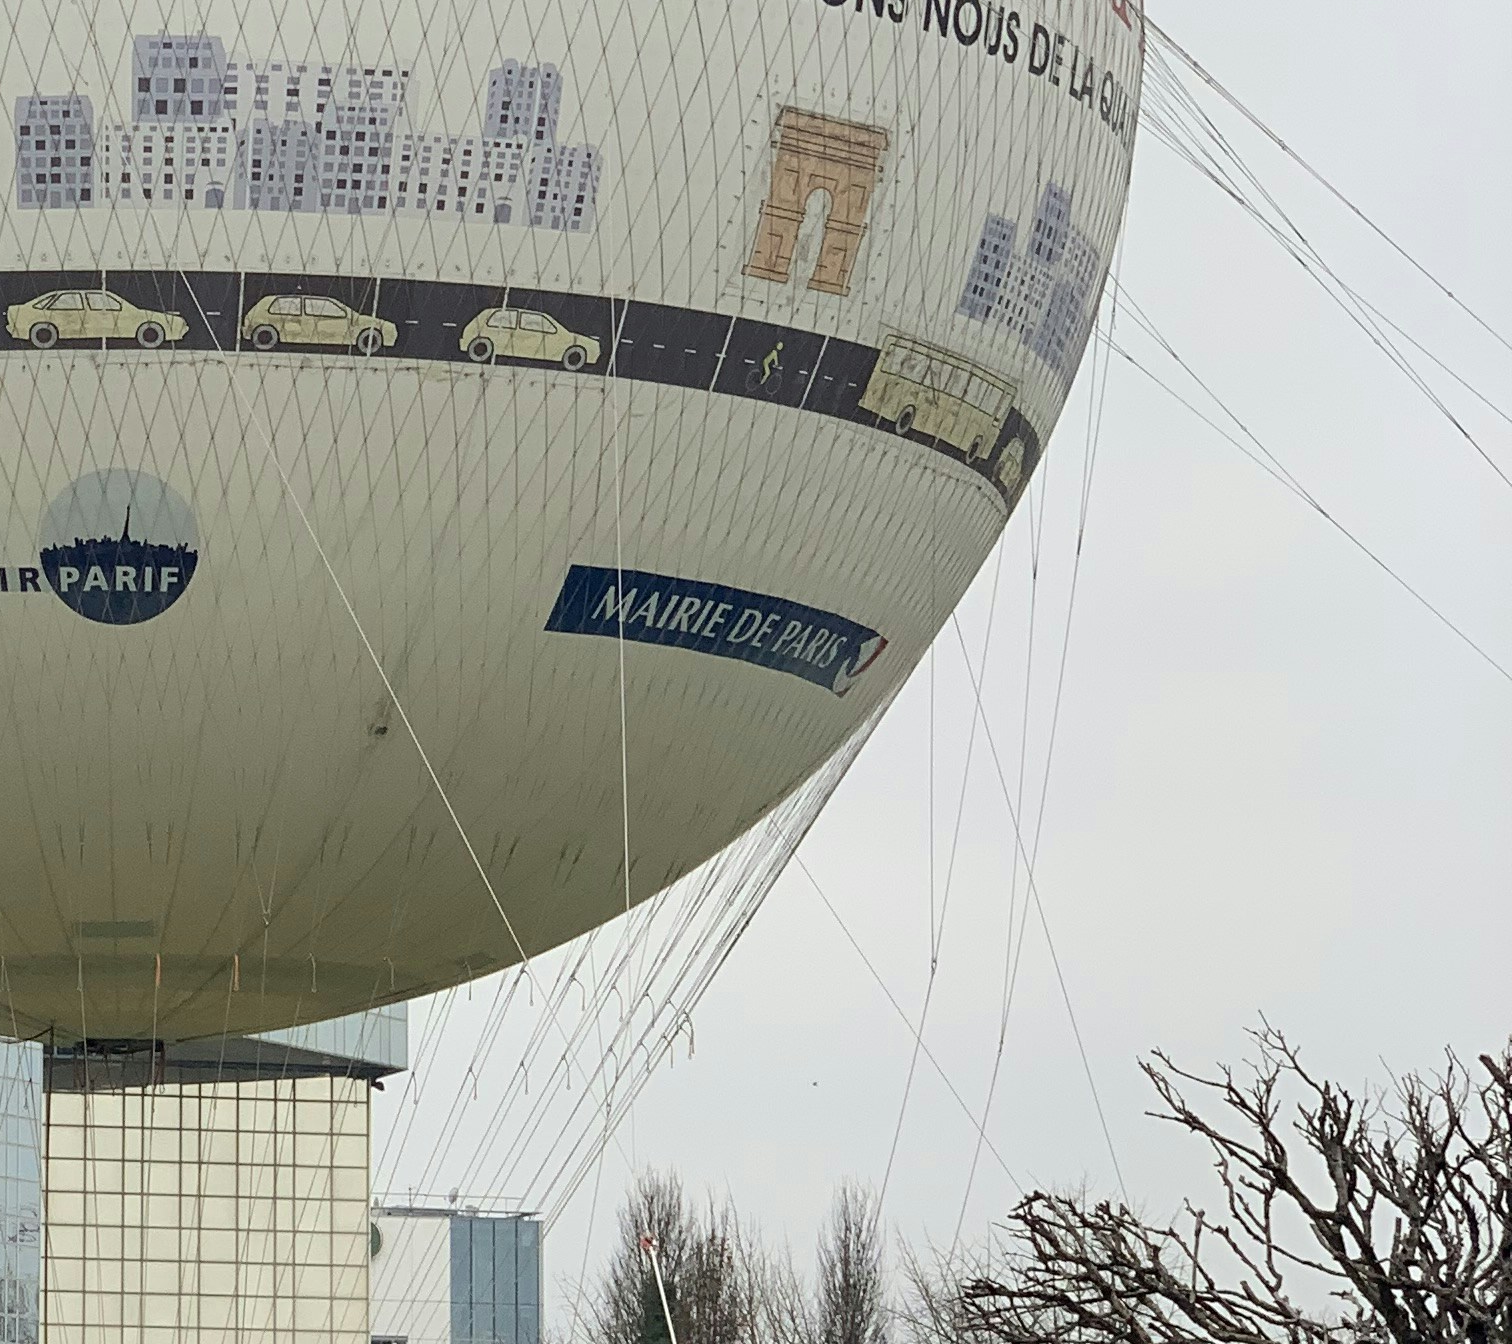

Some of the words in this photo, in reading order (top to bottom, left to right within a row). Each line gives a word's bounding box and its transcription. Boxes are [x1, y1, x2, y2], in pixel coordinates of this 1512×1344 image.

[1028, 22, 1066, 87] DE
[1069, 45, 1094, 110] LA
[59, 566, 180, 593] PARIF
[591, 585, 734, 639] MAIRIE
[726, 608, 781, 649] DE
[773, 620, 849, 669] PARIS
